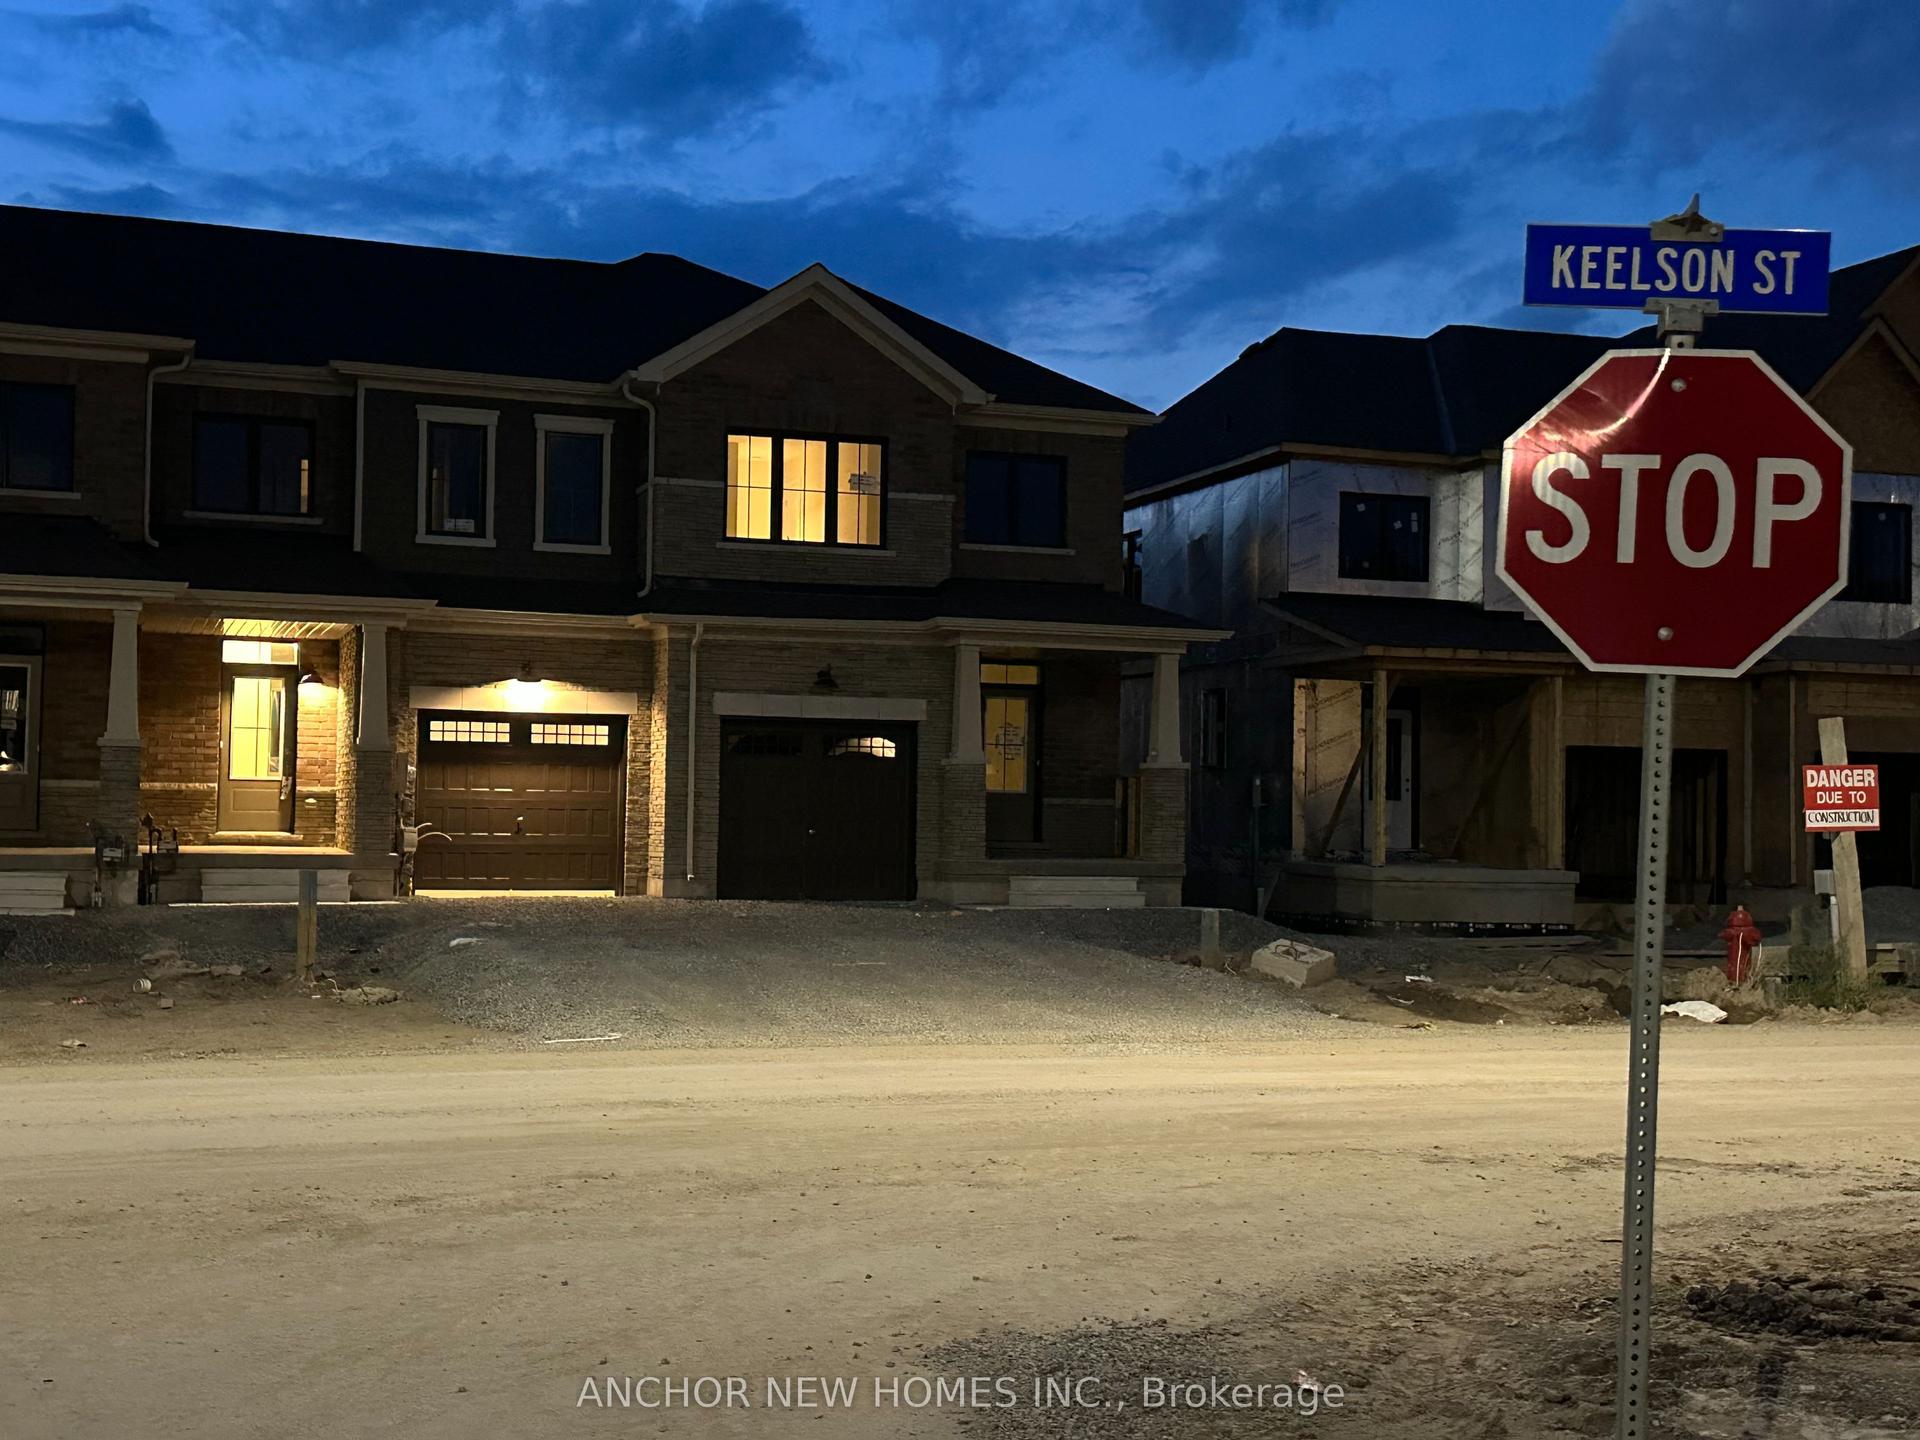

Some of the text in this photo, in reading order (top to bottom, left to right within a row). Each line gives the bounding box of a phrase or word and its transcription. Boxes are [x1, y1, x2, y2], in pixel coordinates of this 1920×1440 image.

[1551, 245, 1801, 295] KEELSON ST
[1525, 452, 1823, 568] STOP
[1806, 769, 1875, 788] DANGER
[1816, 791, 1867, 804] DUE TO
[1807, 810, 1875, 824] CONSTRUCTION
